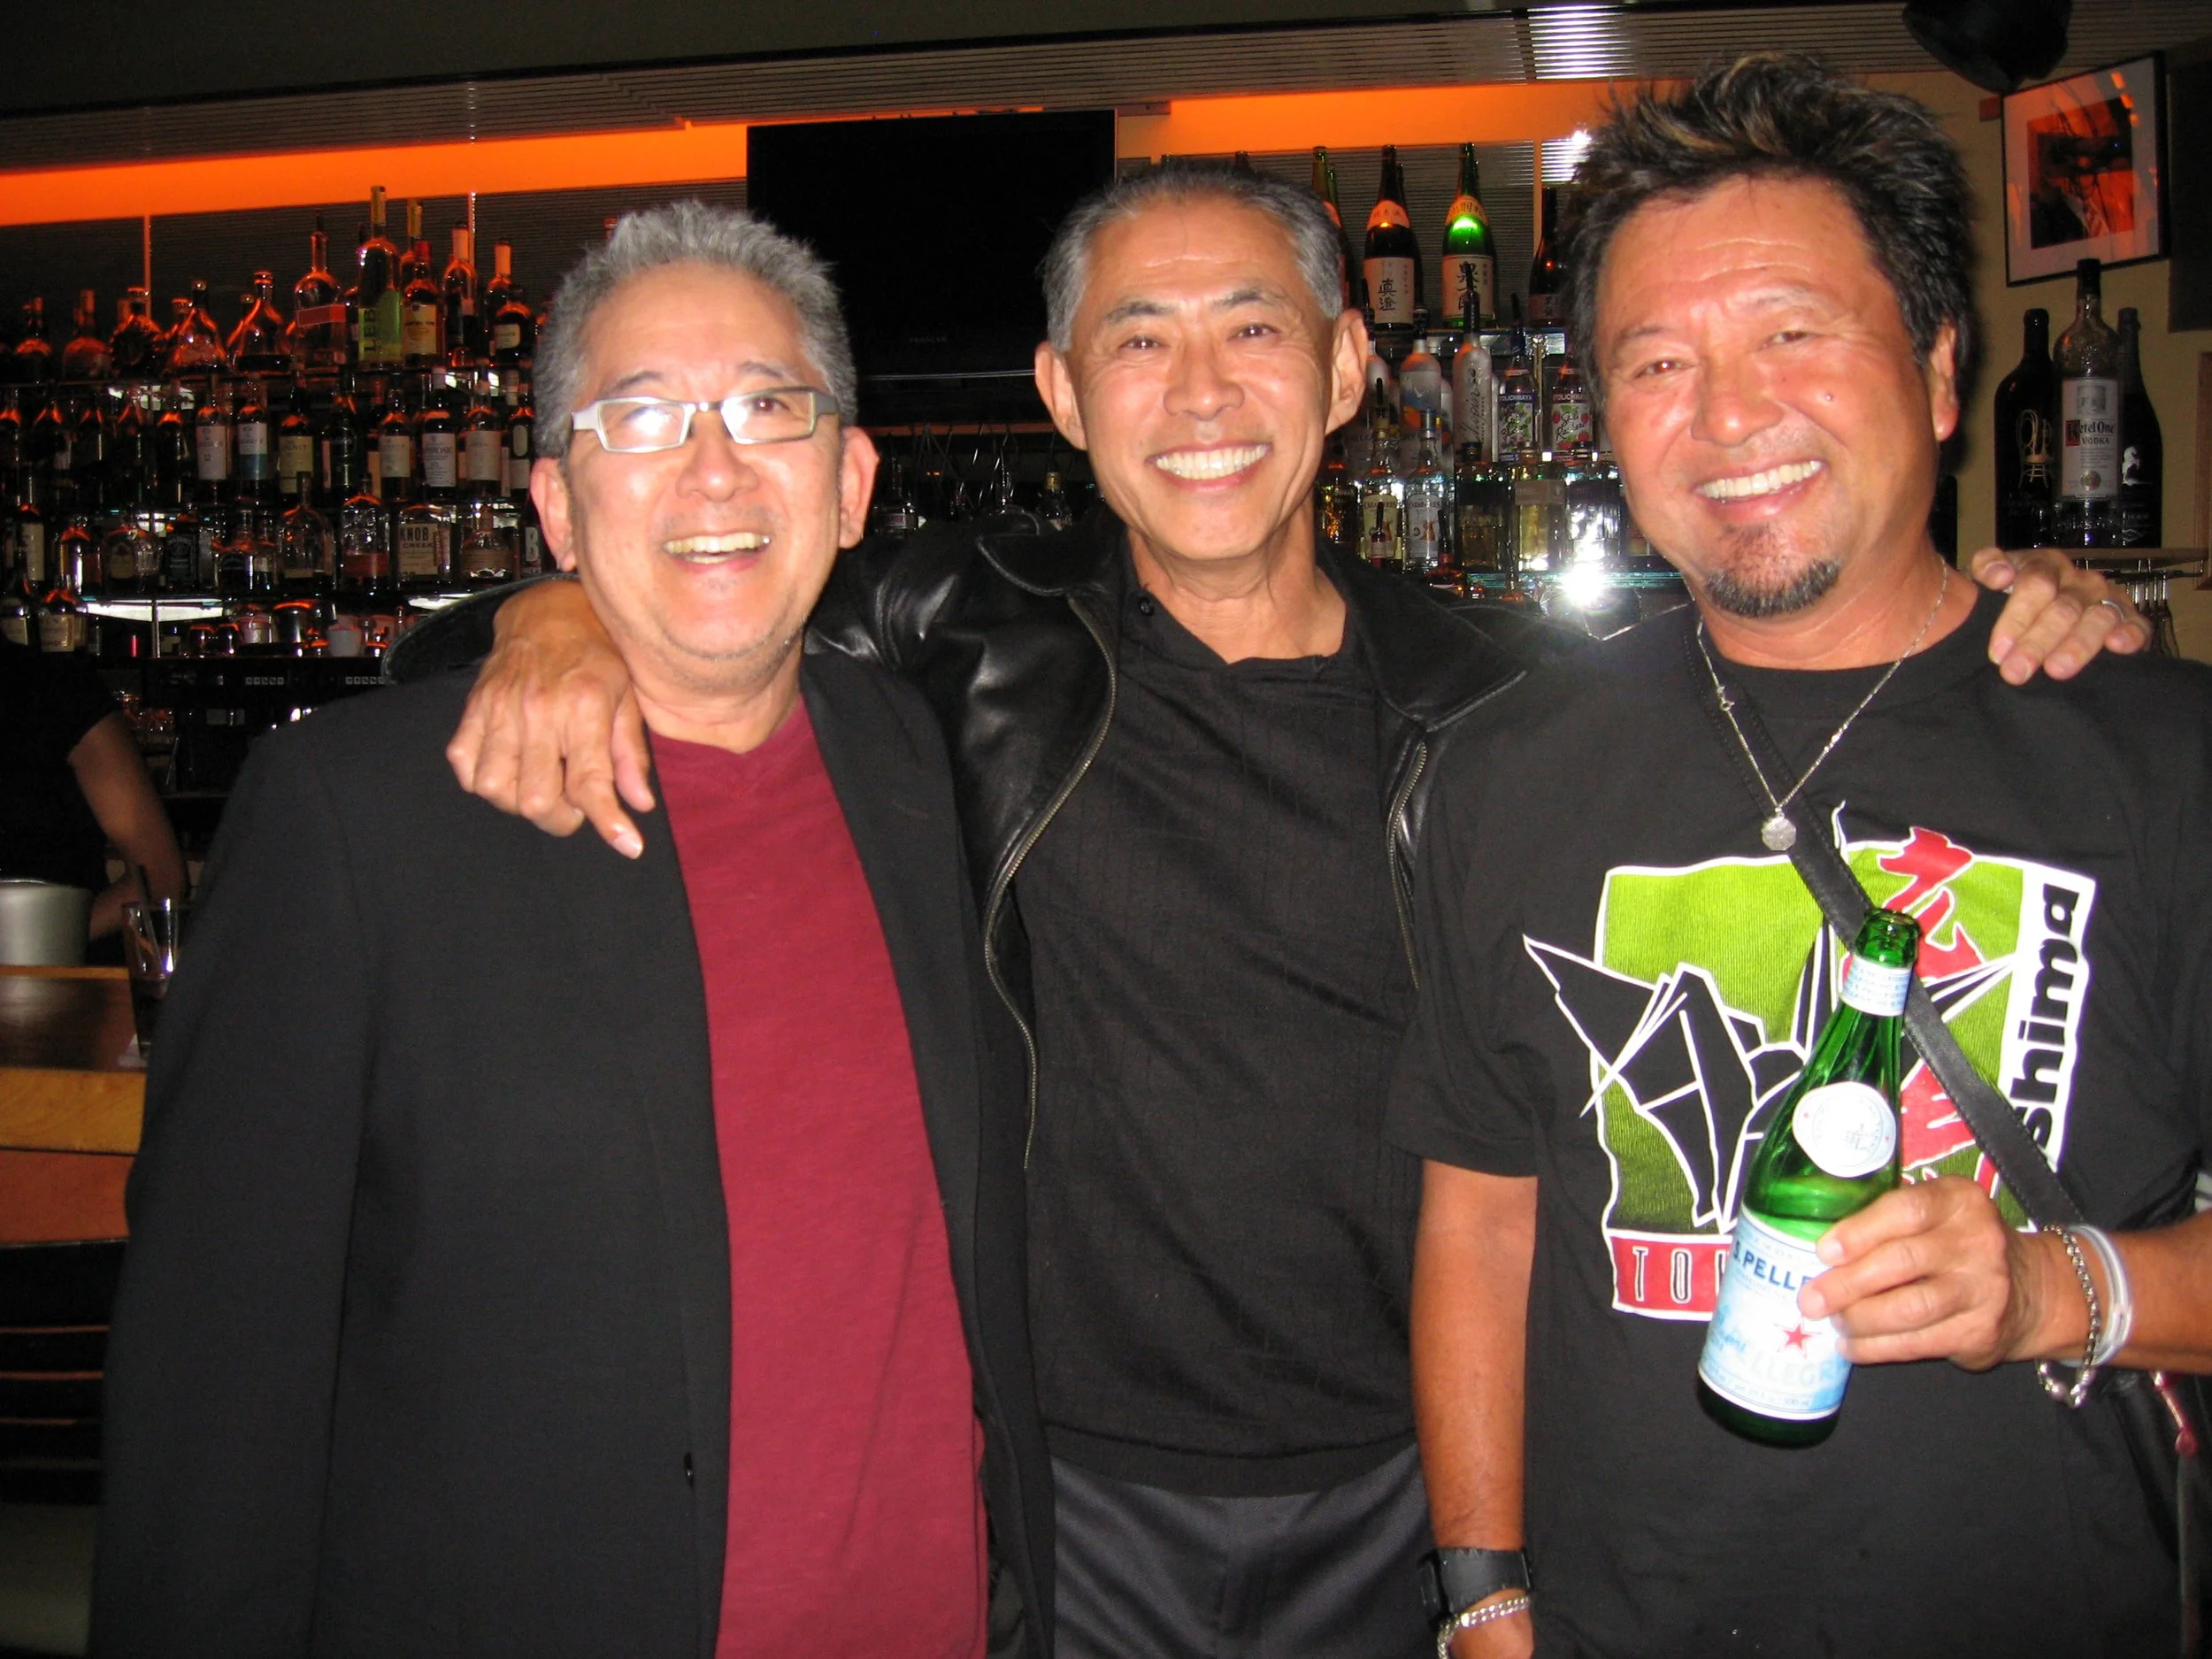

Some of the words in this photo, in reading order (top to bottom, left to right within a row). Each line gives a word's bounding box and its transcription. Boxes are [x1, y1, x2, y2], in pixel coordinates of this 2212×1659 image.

[2067, 421, 2096, 442] Ketel
[2097, 420, 2115, 434] One
[2081, 436, 2110, 445] VODKA
[400, 526, 429, 541] KNOB
